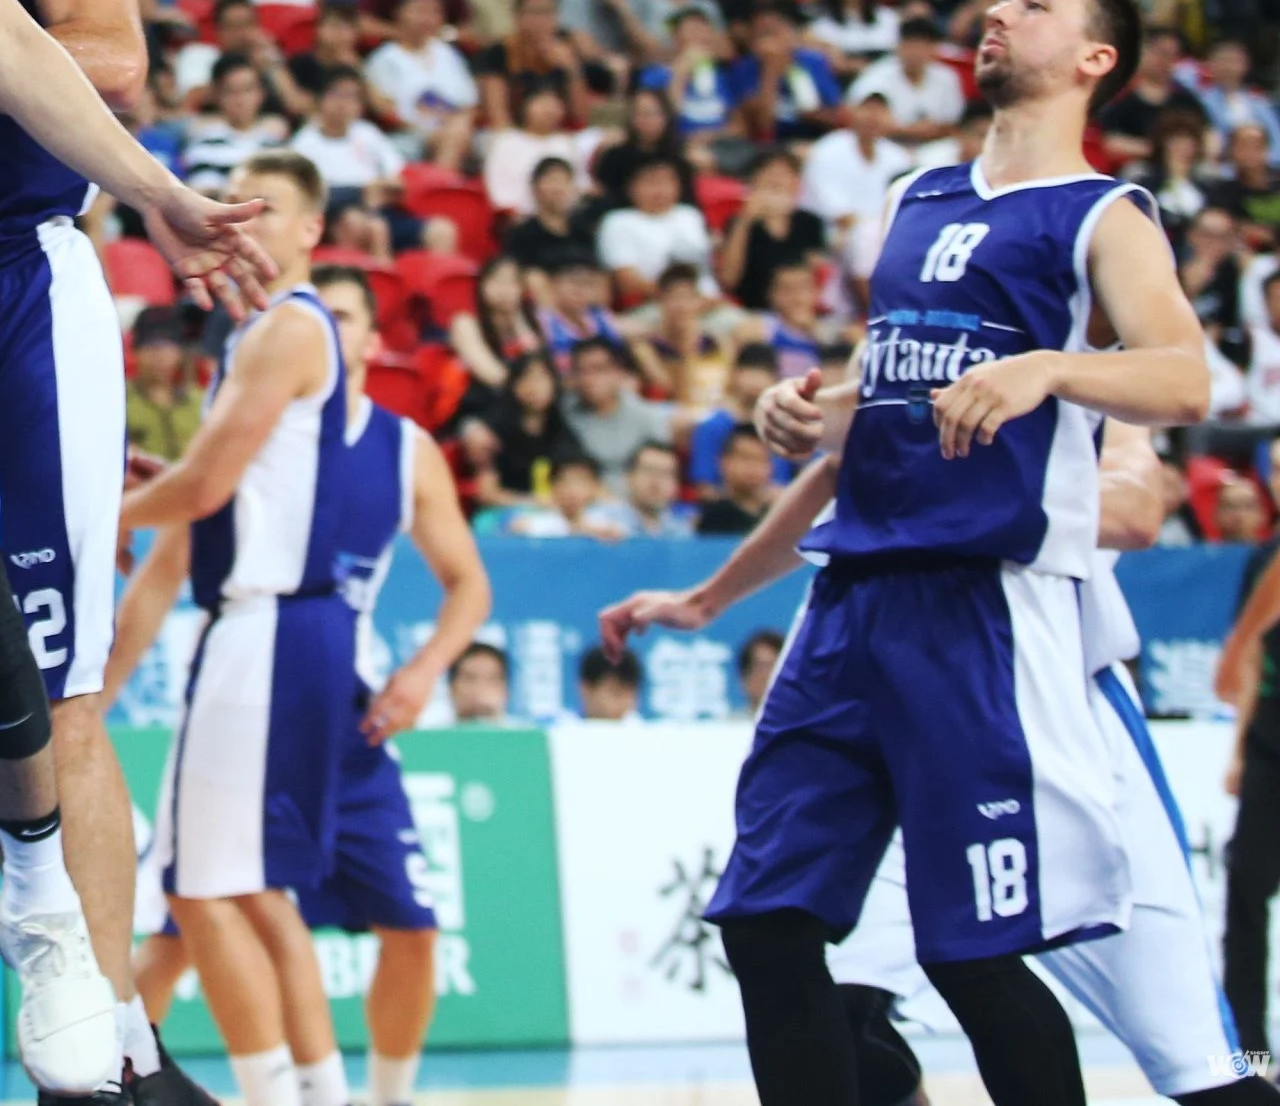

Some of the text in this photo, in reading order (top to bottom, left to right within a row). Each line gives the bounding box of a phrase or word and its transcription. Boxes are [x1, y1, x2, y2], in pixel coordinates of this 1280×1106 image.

[920, 212, 990, 283] 18
[13, 587, 69, 671] 2
[965, 837, 1029, 923] 18
